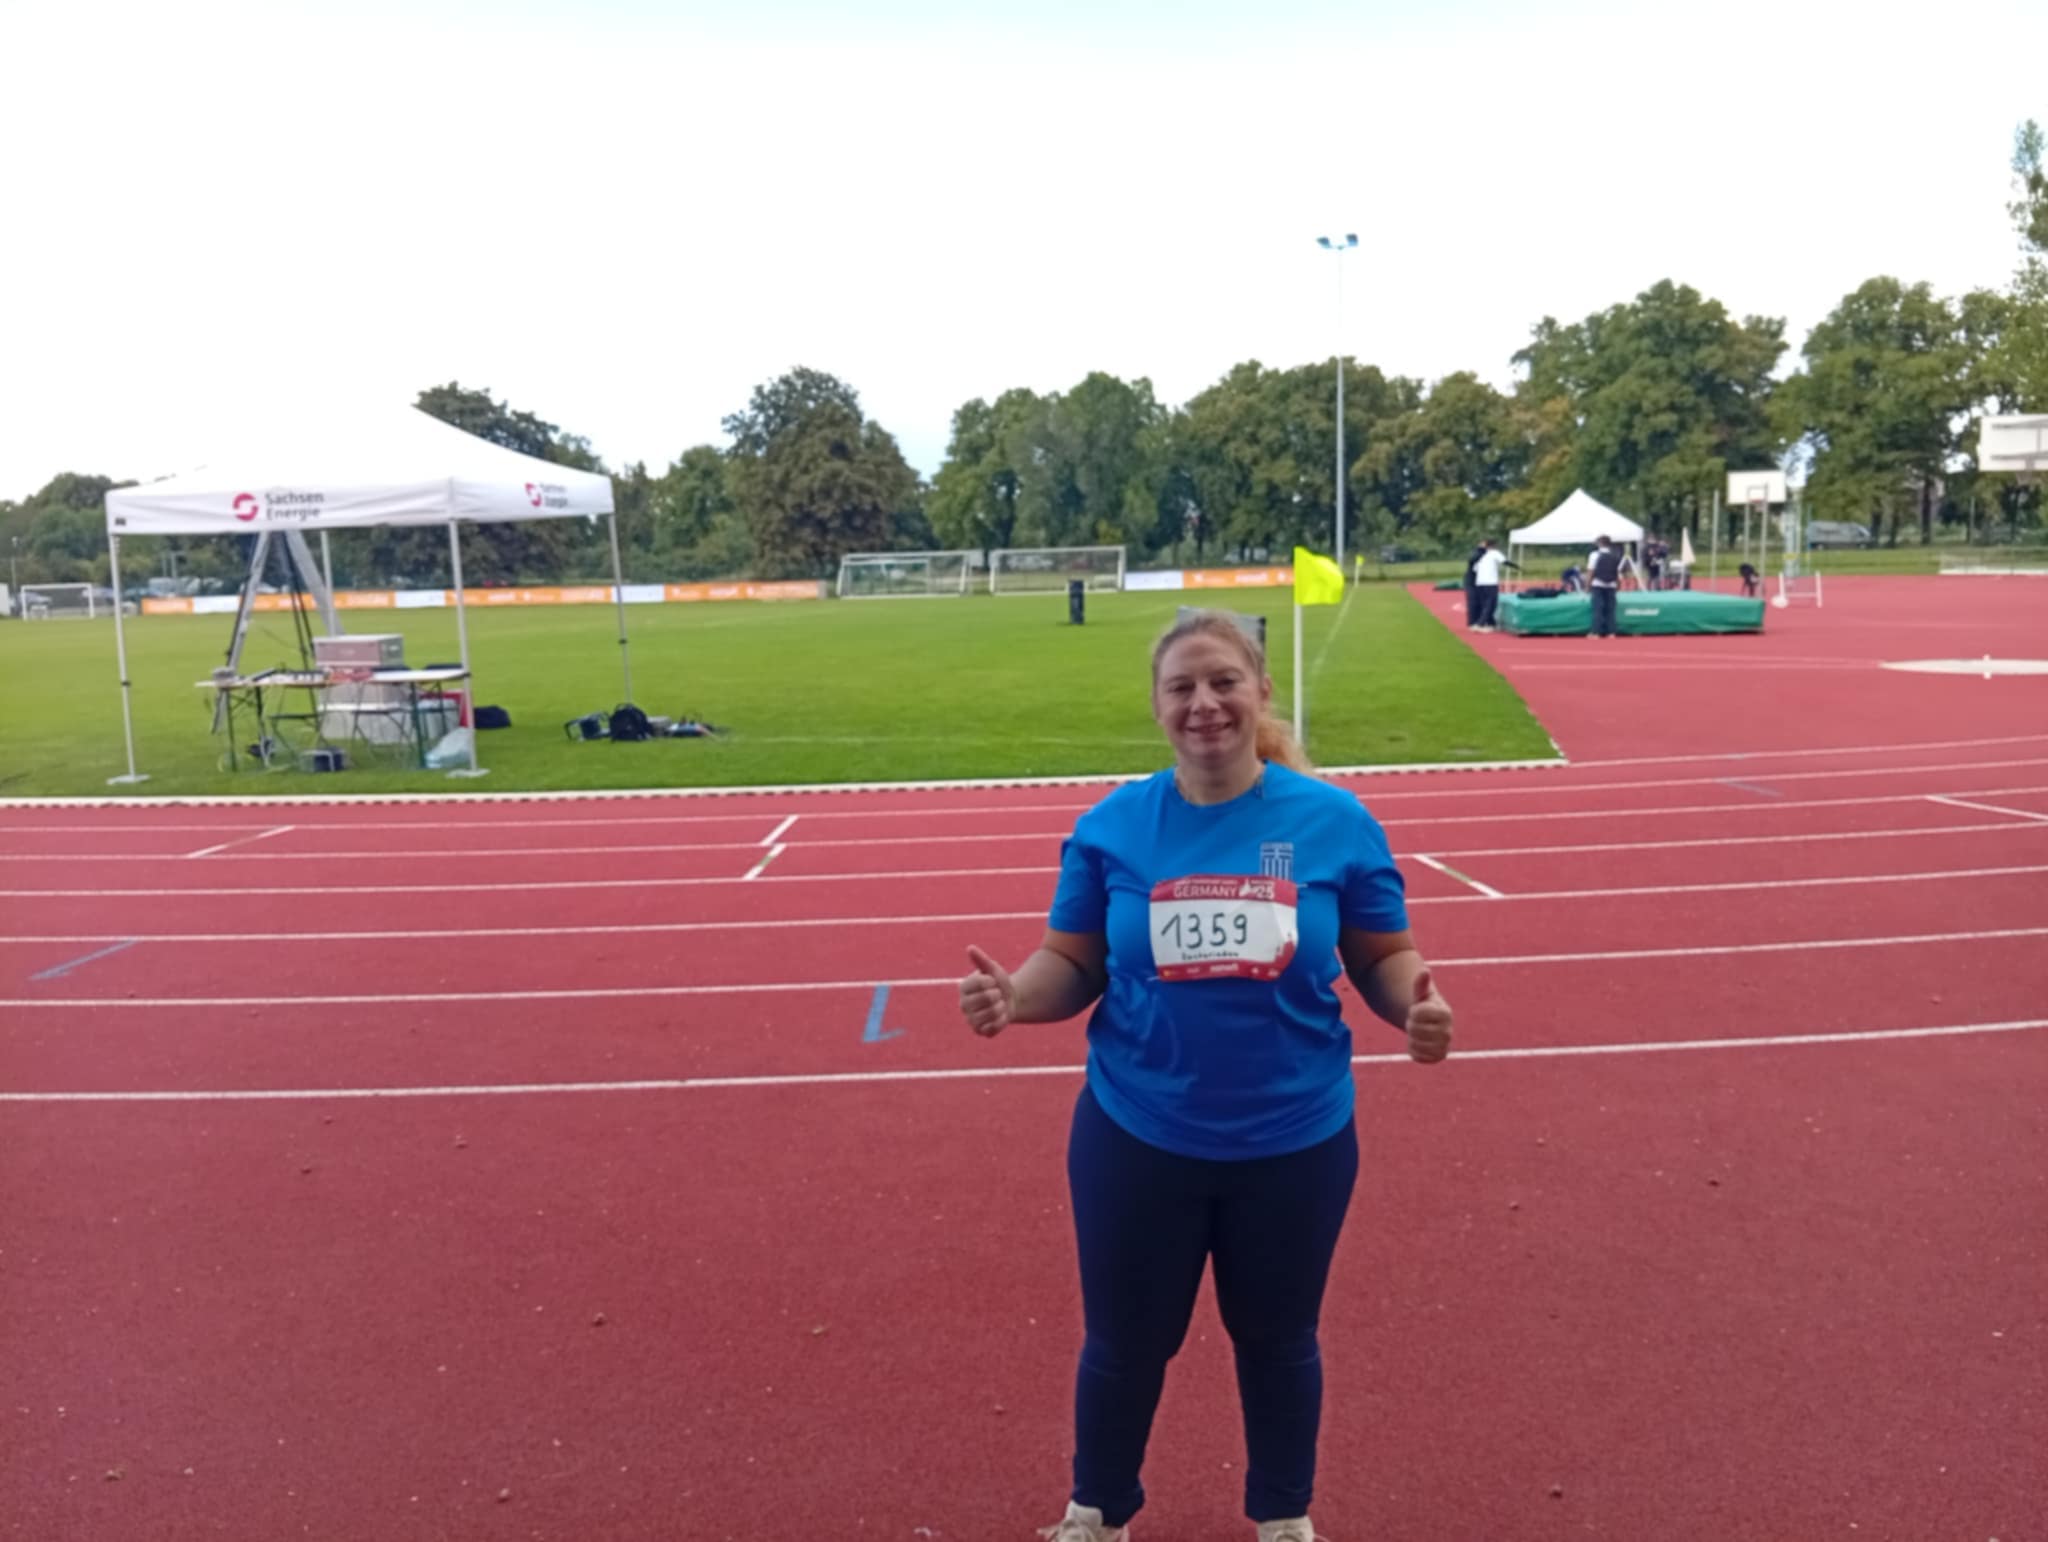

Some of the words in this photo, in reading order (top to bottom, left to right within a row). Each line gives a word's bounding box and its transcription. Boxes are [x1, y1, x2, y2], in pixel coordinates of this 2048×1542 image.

[265, 491, 324, 505] Sachsen
[266, 507, 320, 521] Energie
[1173, 884, 1237, 898] GERMANY
[1160, 912, 1248, 950] 1359
